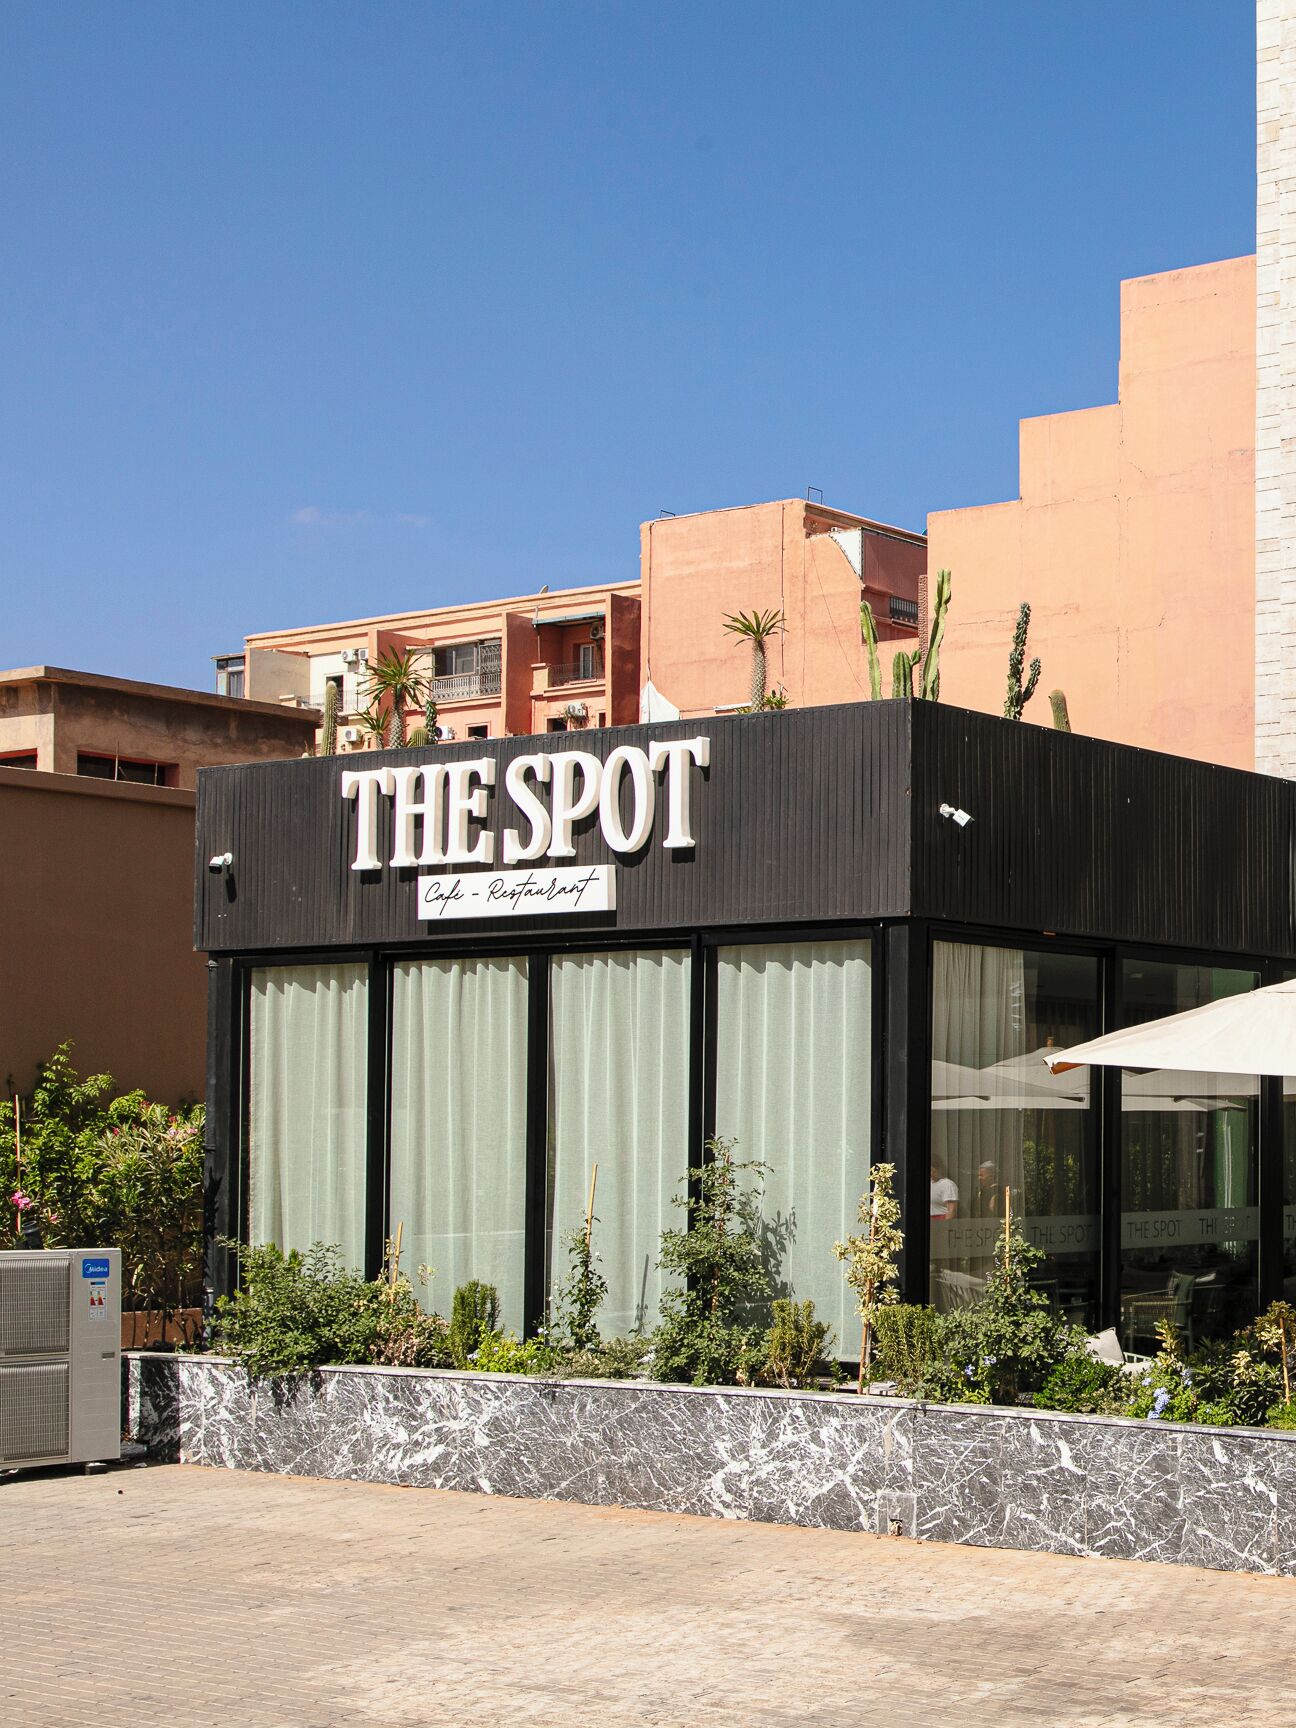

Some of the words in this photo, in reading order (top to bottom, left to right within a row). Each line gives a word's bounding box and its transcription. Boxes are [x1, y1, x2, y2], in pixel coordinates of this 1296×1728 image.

[341, 757, 496, 871] THE
[503, 736, 711, 865] SPOT
[487, 868, 600, 910] Restaurant
[946, 1229, 973, 1249] THE
[1031, 1225, 1056, 1245] THE
[1058, 1224, 1094, 1245] SPOT
[1127, 1221, 1149, 1239] THE
[1153, 1219, 1183, 1239] SPOT
